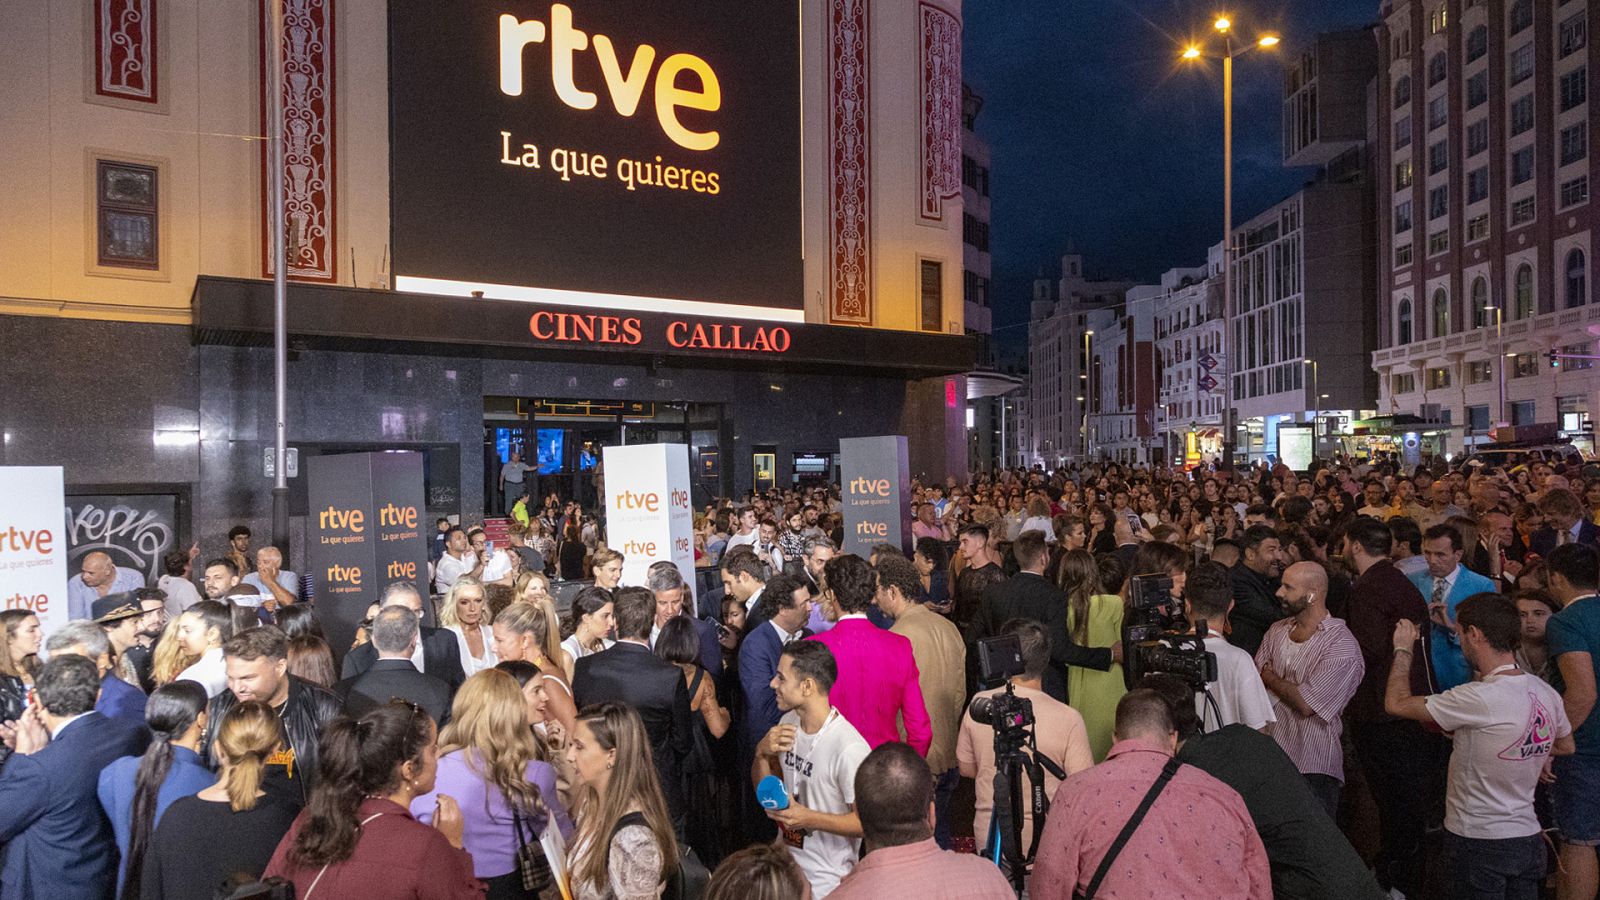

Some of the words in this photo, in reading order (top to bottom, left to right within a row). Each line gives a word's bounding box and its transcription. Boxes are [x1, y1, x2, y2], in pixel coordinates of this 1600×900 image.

[498, 3, 721, 151] rtve
[501, 131, 540, 169] La
[550, 148, 607, 182] que
[617, 156, 721, 195] quieres
[529, 310, 643, 345] CINES
[666, 320, 792, 352] CALLAO
[850, 476, 890, 496] rtve
[616, 490, 659, 512] rtve
[671, 488, 689, 509] rtve
[320, 506, 364, 532] rtve
[380, 503, 418, 529] rtve
[856, 520, 888, 537] rtve
[321, 536, 329, 544] La
[329, 537, 341, 545] que
[342, 535, 364, 545] quieres
[624, 540, 657, 557] rtve
[328, 564, 362, 585] rtve
[388, 560, 417, 579] rtve
[1520, 741, 1551, 758] VANS
[1034, 785, 1042, 814] Canon
